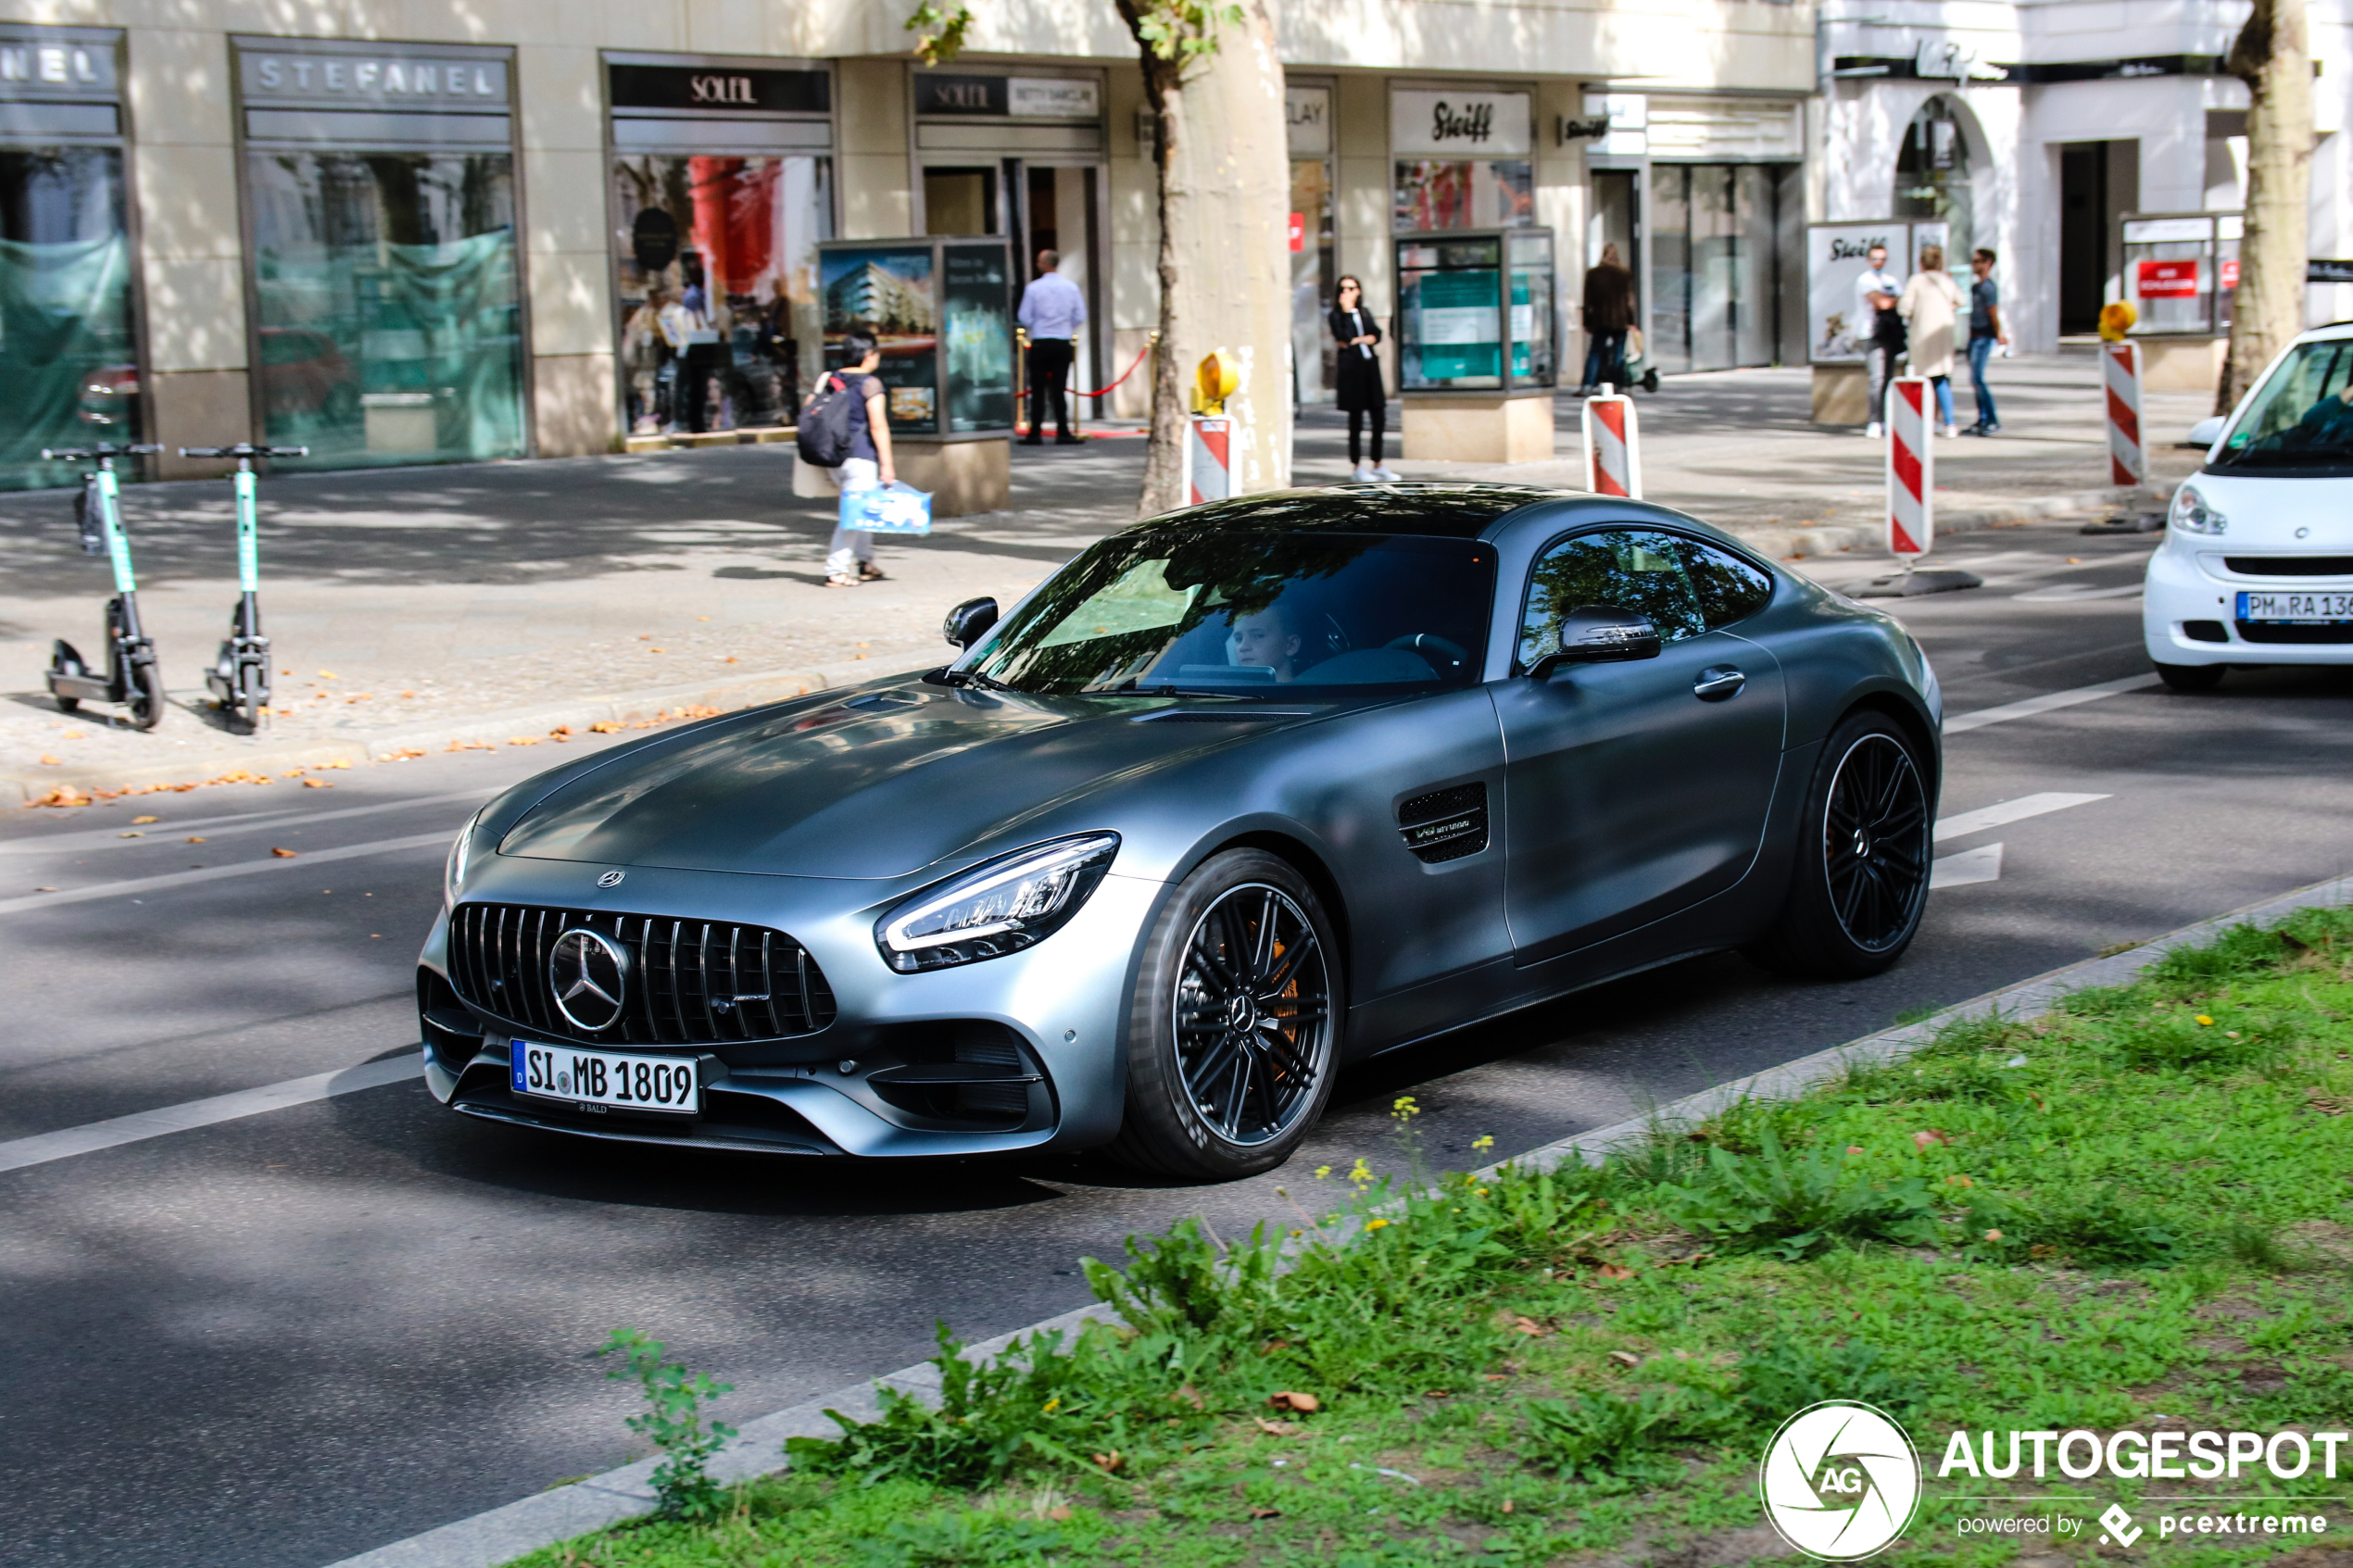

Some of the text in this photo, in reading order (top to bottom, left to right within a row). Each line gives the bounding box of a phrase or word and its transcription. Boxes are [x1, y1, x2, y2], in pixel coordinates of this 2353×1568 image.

[258, 57, 494, 94] STEFANEL
[690, 75, 758, 104] SOLEIL
[1432, 101, 1493, 143] Steiff
[2250, 596, 2275, 615] PM
[2290, 596, 2315, 615] RA
[529, 1049, 692, 1104] SI MB 1809
[586, 1104, 607, 1114] BALD
